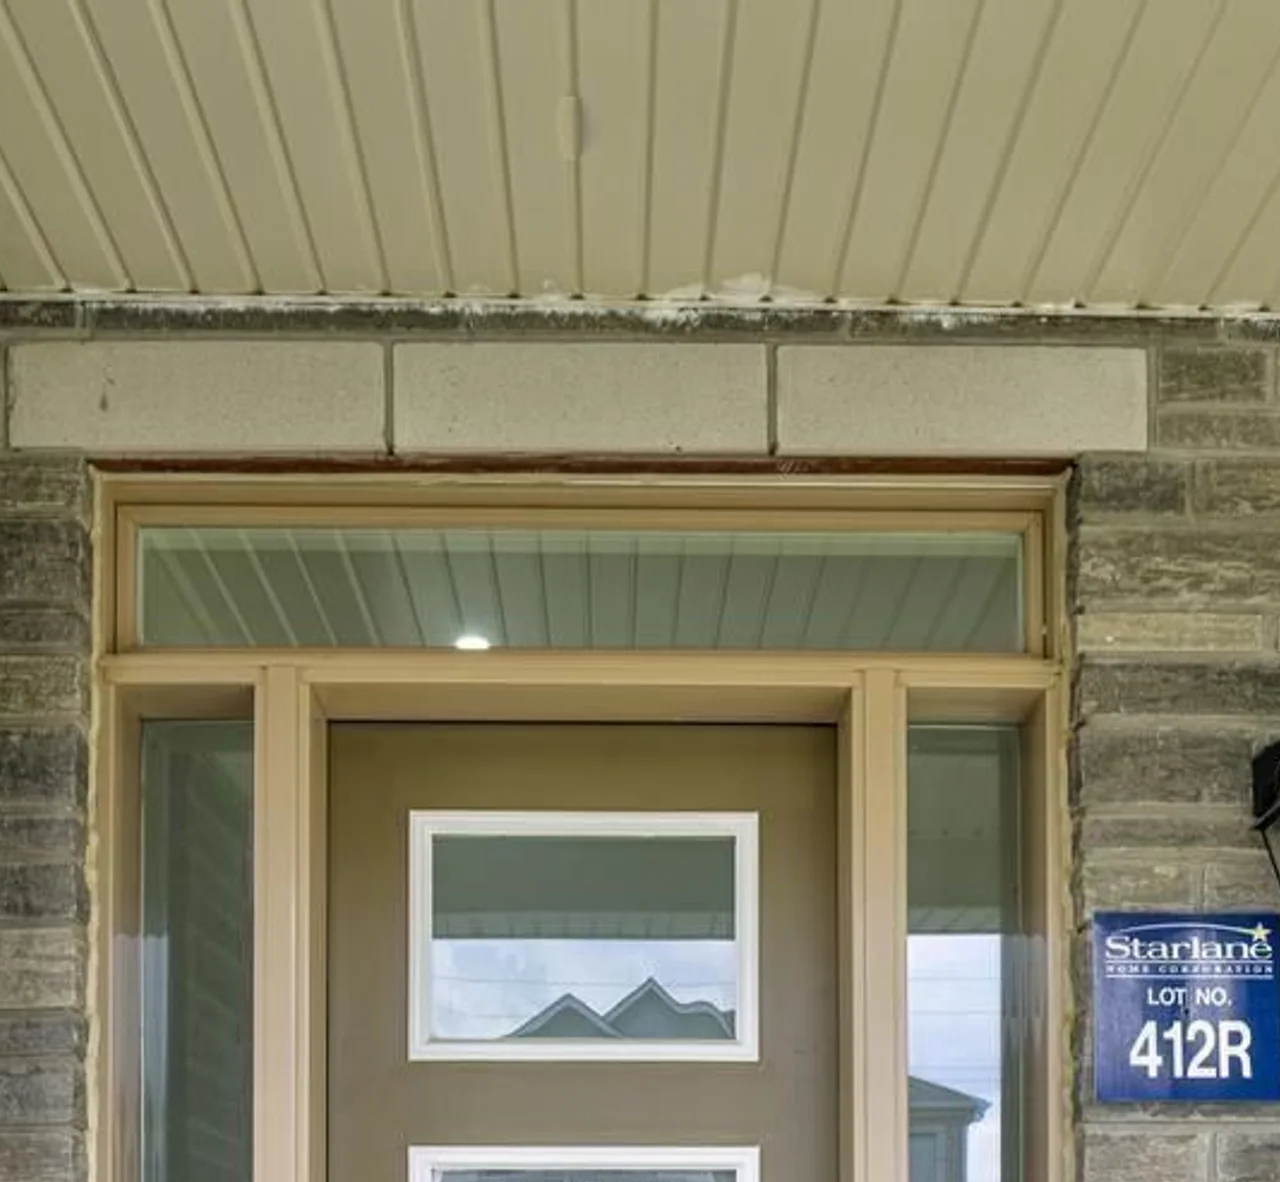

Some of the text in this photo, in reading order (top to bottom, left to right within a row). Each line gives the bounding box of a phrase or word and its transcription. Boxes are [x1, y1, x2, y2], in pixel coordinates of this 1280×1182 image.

[1106, 936, 1273, 959] Starlane
[1106, 965, 1273, 974] HOME CORPORATION
[1147, 987, 1233, 1006] LOT NO.
[1129, 1020, 1253, 1079] 412R
